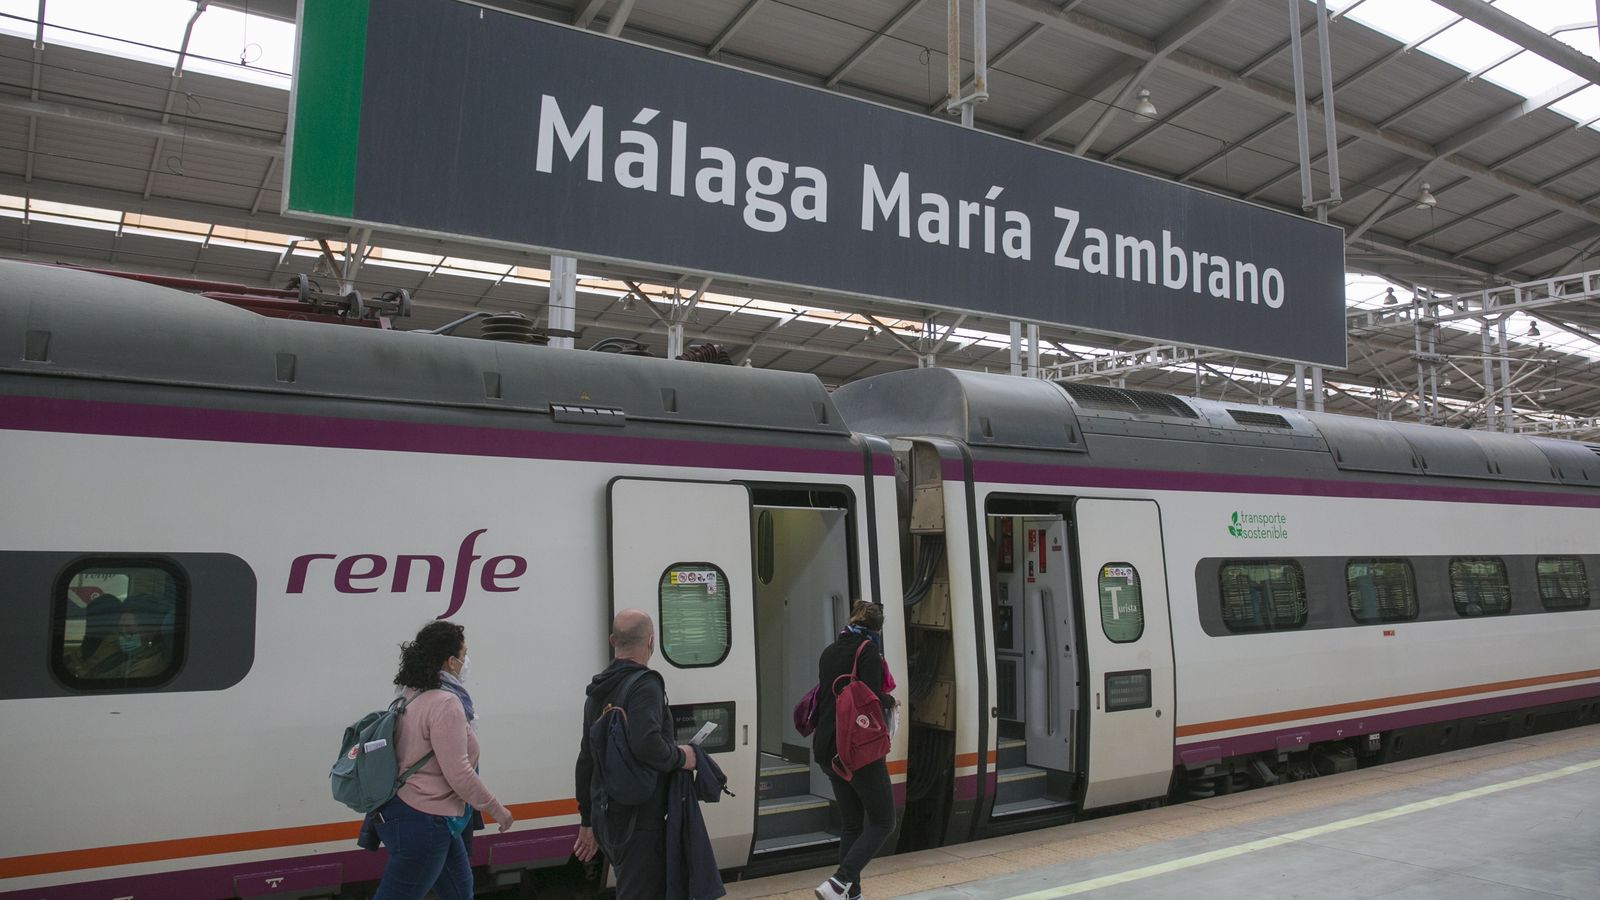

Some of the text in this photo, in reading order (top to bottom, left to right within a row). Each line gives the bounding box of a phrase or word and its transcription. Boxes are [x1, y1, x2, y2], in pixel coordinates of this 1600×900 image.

[535, 94, 1285, 309] Málaga María Zambrano
[1240, 511, 1287, 527] transporte
[1243, 525, 1288, 539] sostenible
[285, 528, 528, 620] renfe
[1104, 586, 1138, 620] Turista
